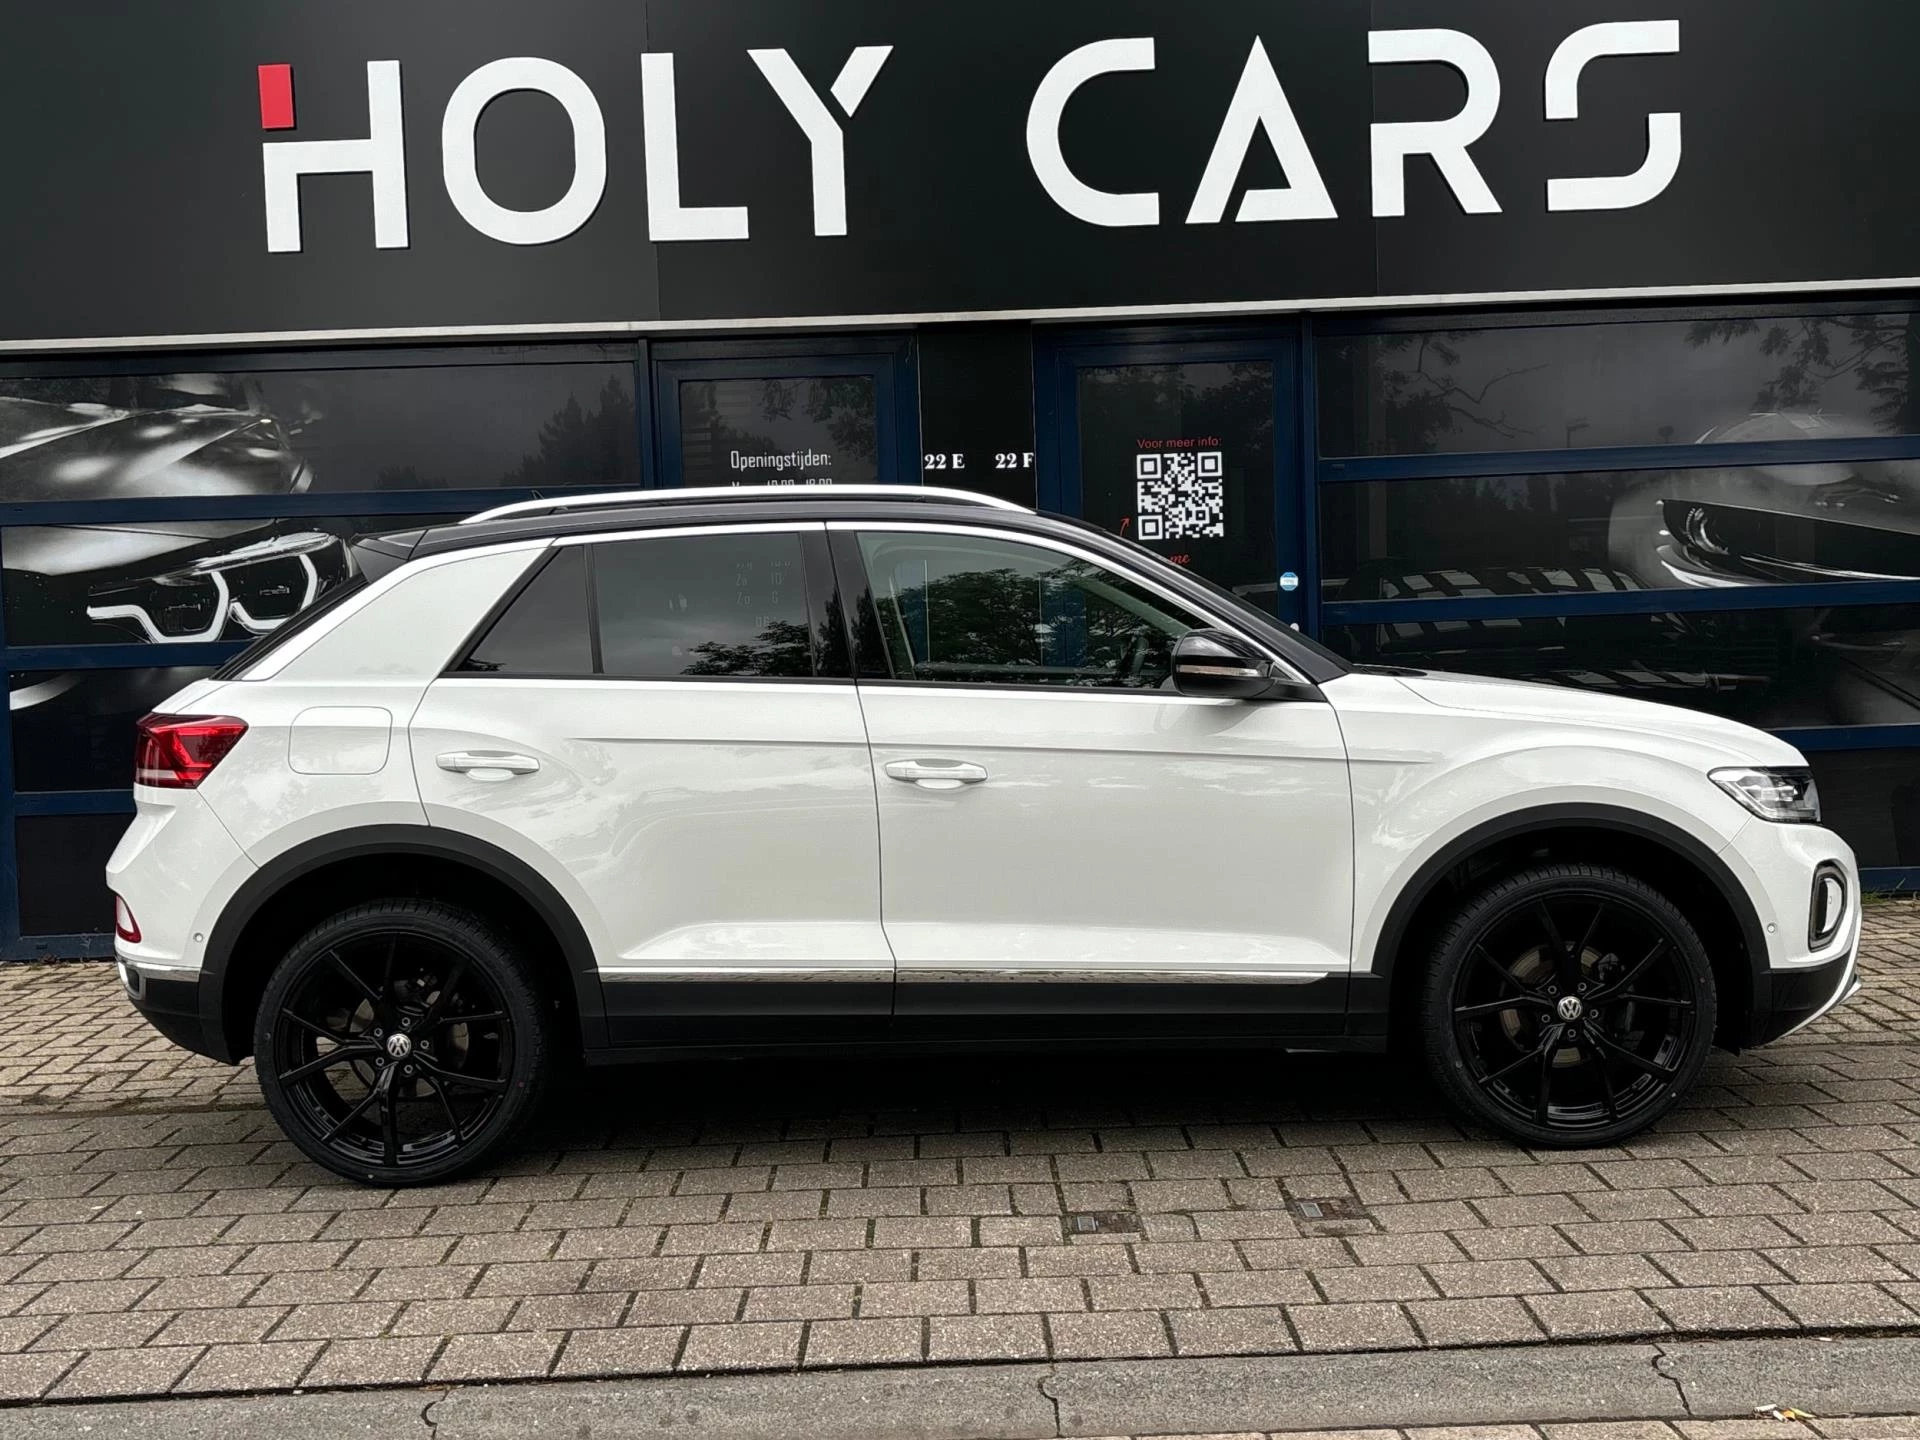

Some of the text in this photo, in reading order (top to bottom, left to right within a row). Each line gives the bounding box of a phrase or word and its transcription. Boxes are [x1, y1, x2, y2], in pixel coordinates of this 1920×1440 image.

[258, 20, 1683, 254] HOLY CARS
[1137, 438, 1163, 449] Voor
[1166, 438, 1195, 448] meer
[730, 448, 832, 472] Openingstijden:
[924, 453, 965, 470] 22 E
[995, 452, 1035, 469] 22 F
